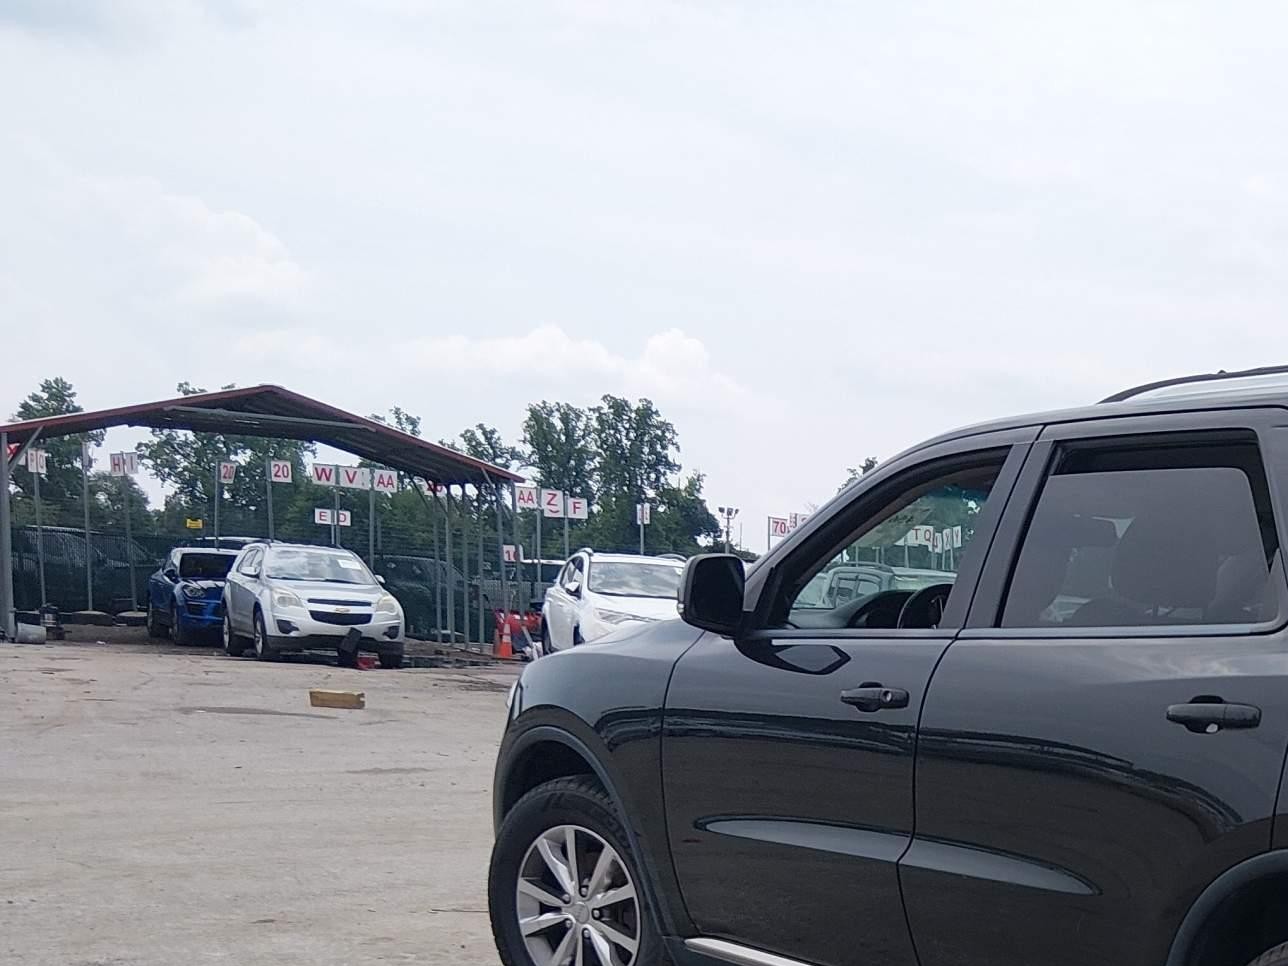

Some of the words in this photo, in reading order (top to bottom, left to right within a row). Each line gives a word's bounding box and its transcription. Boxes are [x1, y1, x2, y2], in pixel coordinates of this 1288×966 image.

[112, 459, 120, 472] H
[222, 464, 234, 480] 20
[273, 463, 290, 479] 20
[314, 466, 333, 482] W
[344, 469, 358, 484] V
[376, 474, 395, 489] AA
[518, 490, 535, 504] AA
[572, 501, 582, 514] F
[319, 511, 328, 522] E
[338, 512, 347, 523] D
[772, 520, 787, 534] 70
[912, 528, 921, 541] T
[924, 529, 932, 543] Q
